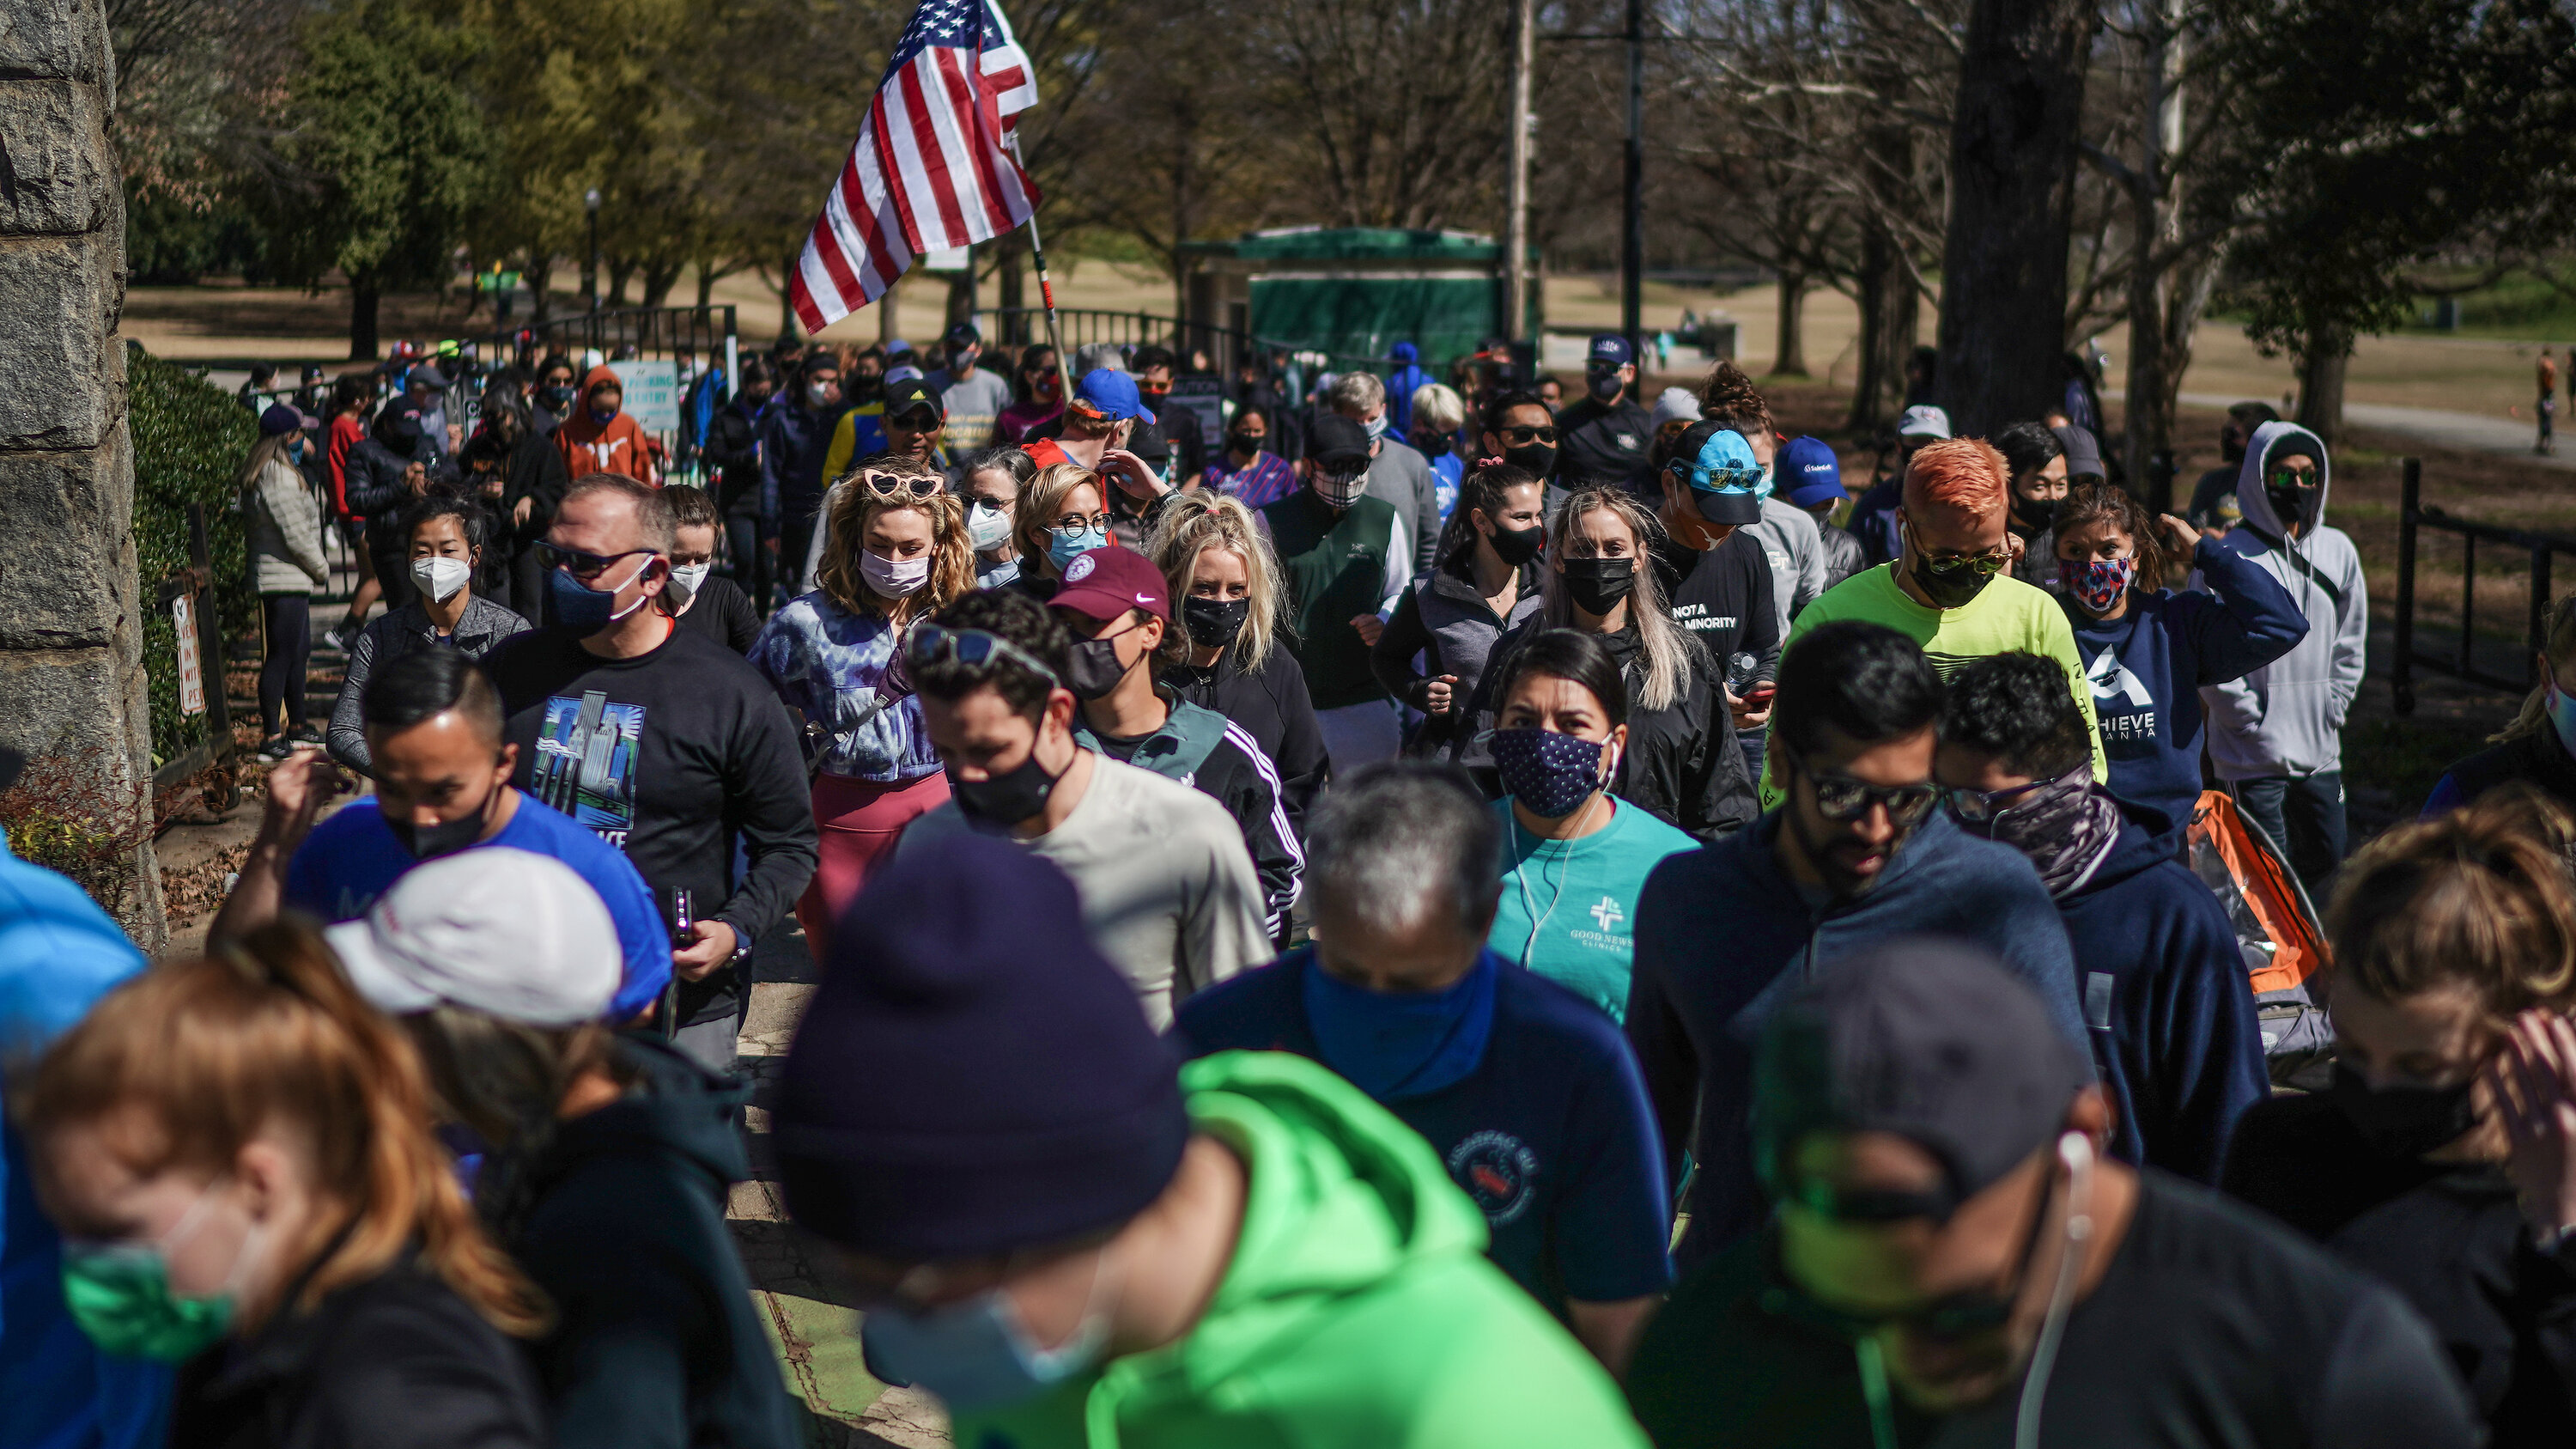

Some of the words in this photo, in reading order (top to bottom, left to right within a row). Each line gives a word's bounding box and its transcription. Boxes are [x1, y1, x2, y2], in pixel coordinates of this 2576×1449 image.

[1672, 604, 1697, 618] NOT
[1697, 603, 1707, 615] A
[1684, 617, 1735, 630] MINORITY
[2099, 712, 2154, 732] HIEVE
[2105, 728, 2155, 740] ANTA
[1571, 929, 1601, 941] GOOD
[1604, 935, 1633, 947] NEWS
[1582, 940, 1621, 951] CLINICS
